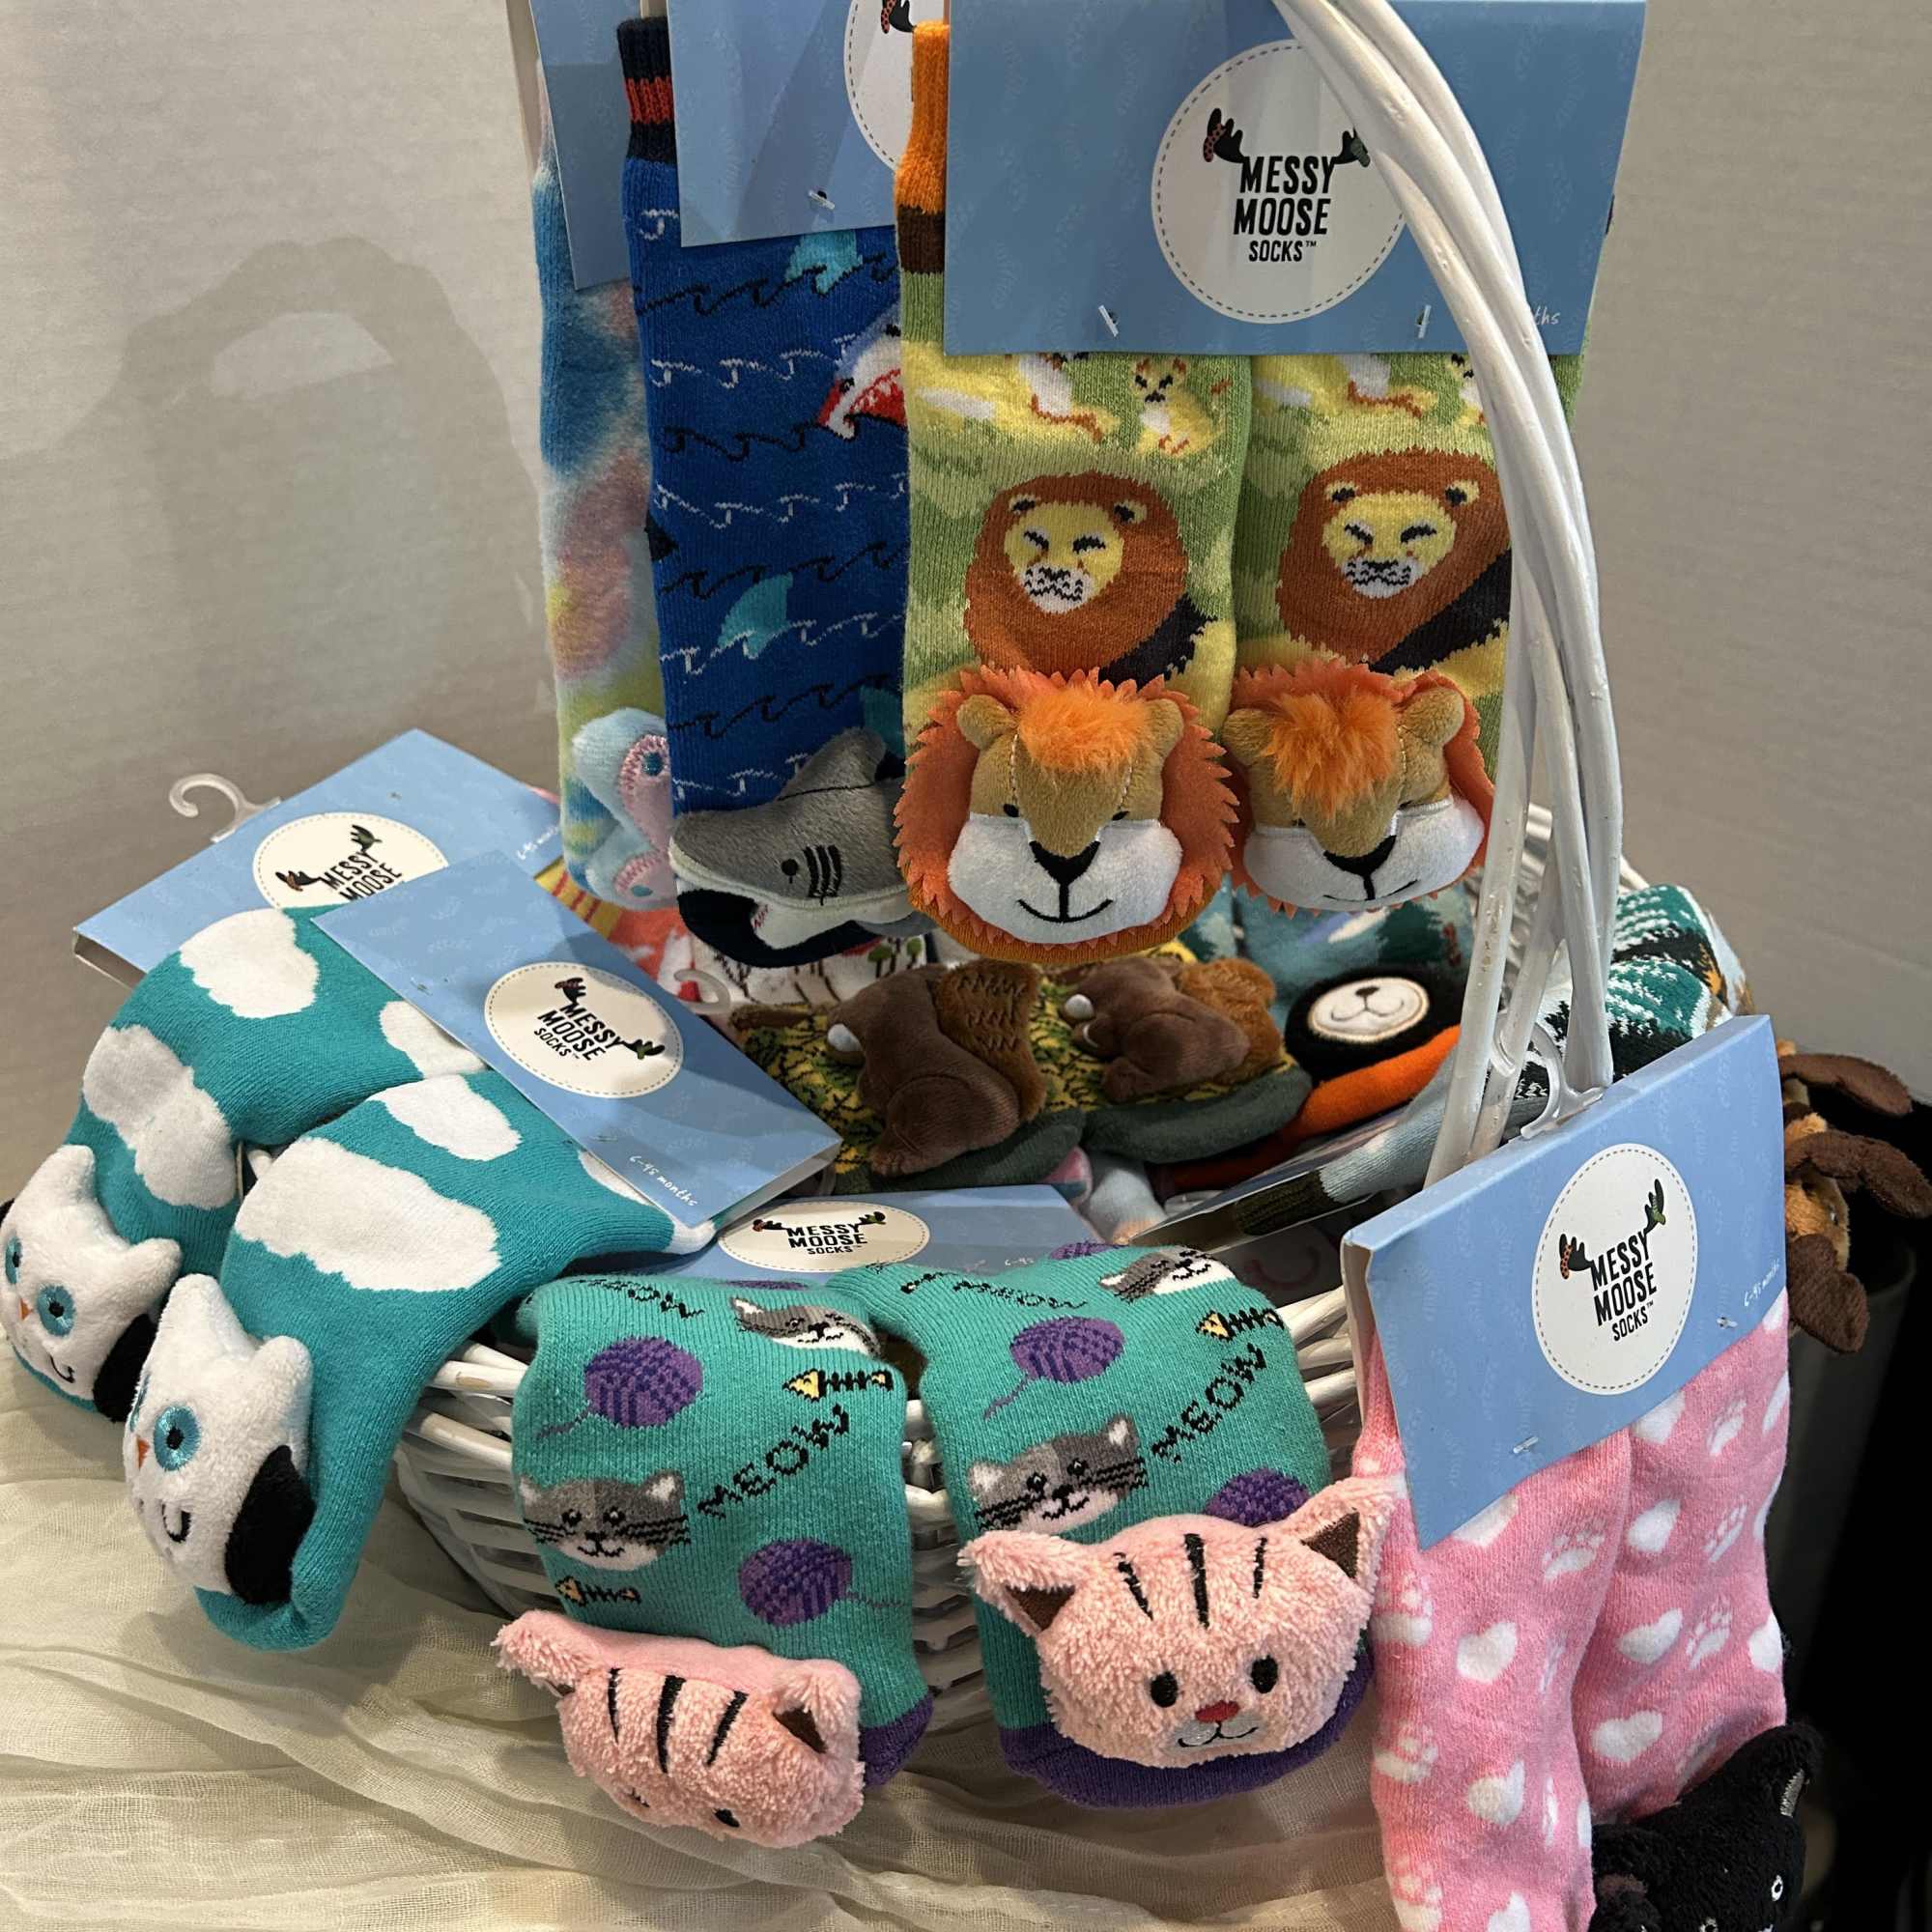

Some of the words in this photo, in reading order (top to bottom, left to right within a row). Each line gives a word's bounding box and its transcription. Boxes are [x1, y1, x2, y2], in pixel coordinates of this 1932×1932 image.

[1239, 156, 1336, 194] MESSY
[1234, 198, 1331, 236] MOOSE
[318, 850, 379, 891] MESSY
[339, 863, 402, 902] MOOSE
[537, 1010, 607, 1061] MOOSE
[559, 1004, 623, 1049] MESSY
[657, 1176, 698, 1207] months
[786, 1224, 859, 1236] MESSY
[788, 1234, 867, 1248] MOOSE
[1591, 1231, 1649, 1292] MESSY
[1594, 1262, 1657, 1326] MOOSE
[1151, 1343, 1266, 1464] MEOW
[697, 1404, 849, 1520] MEOW
